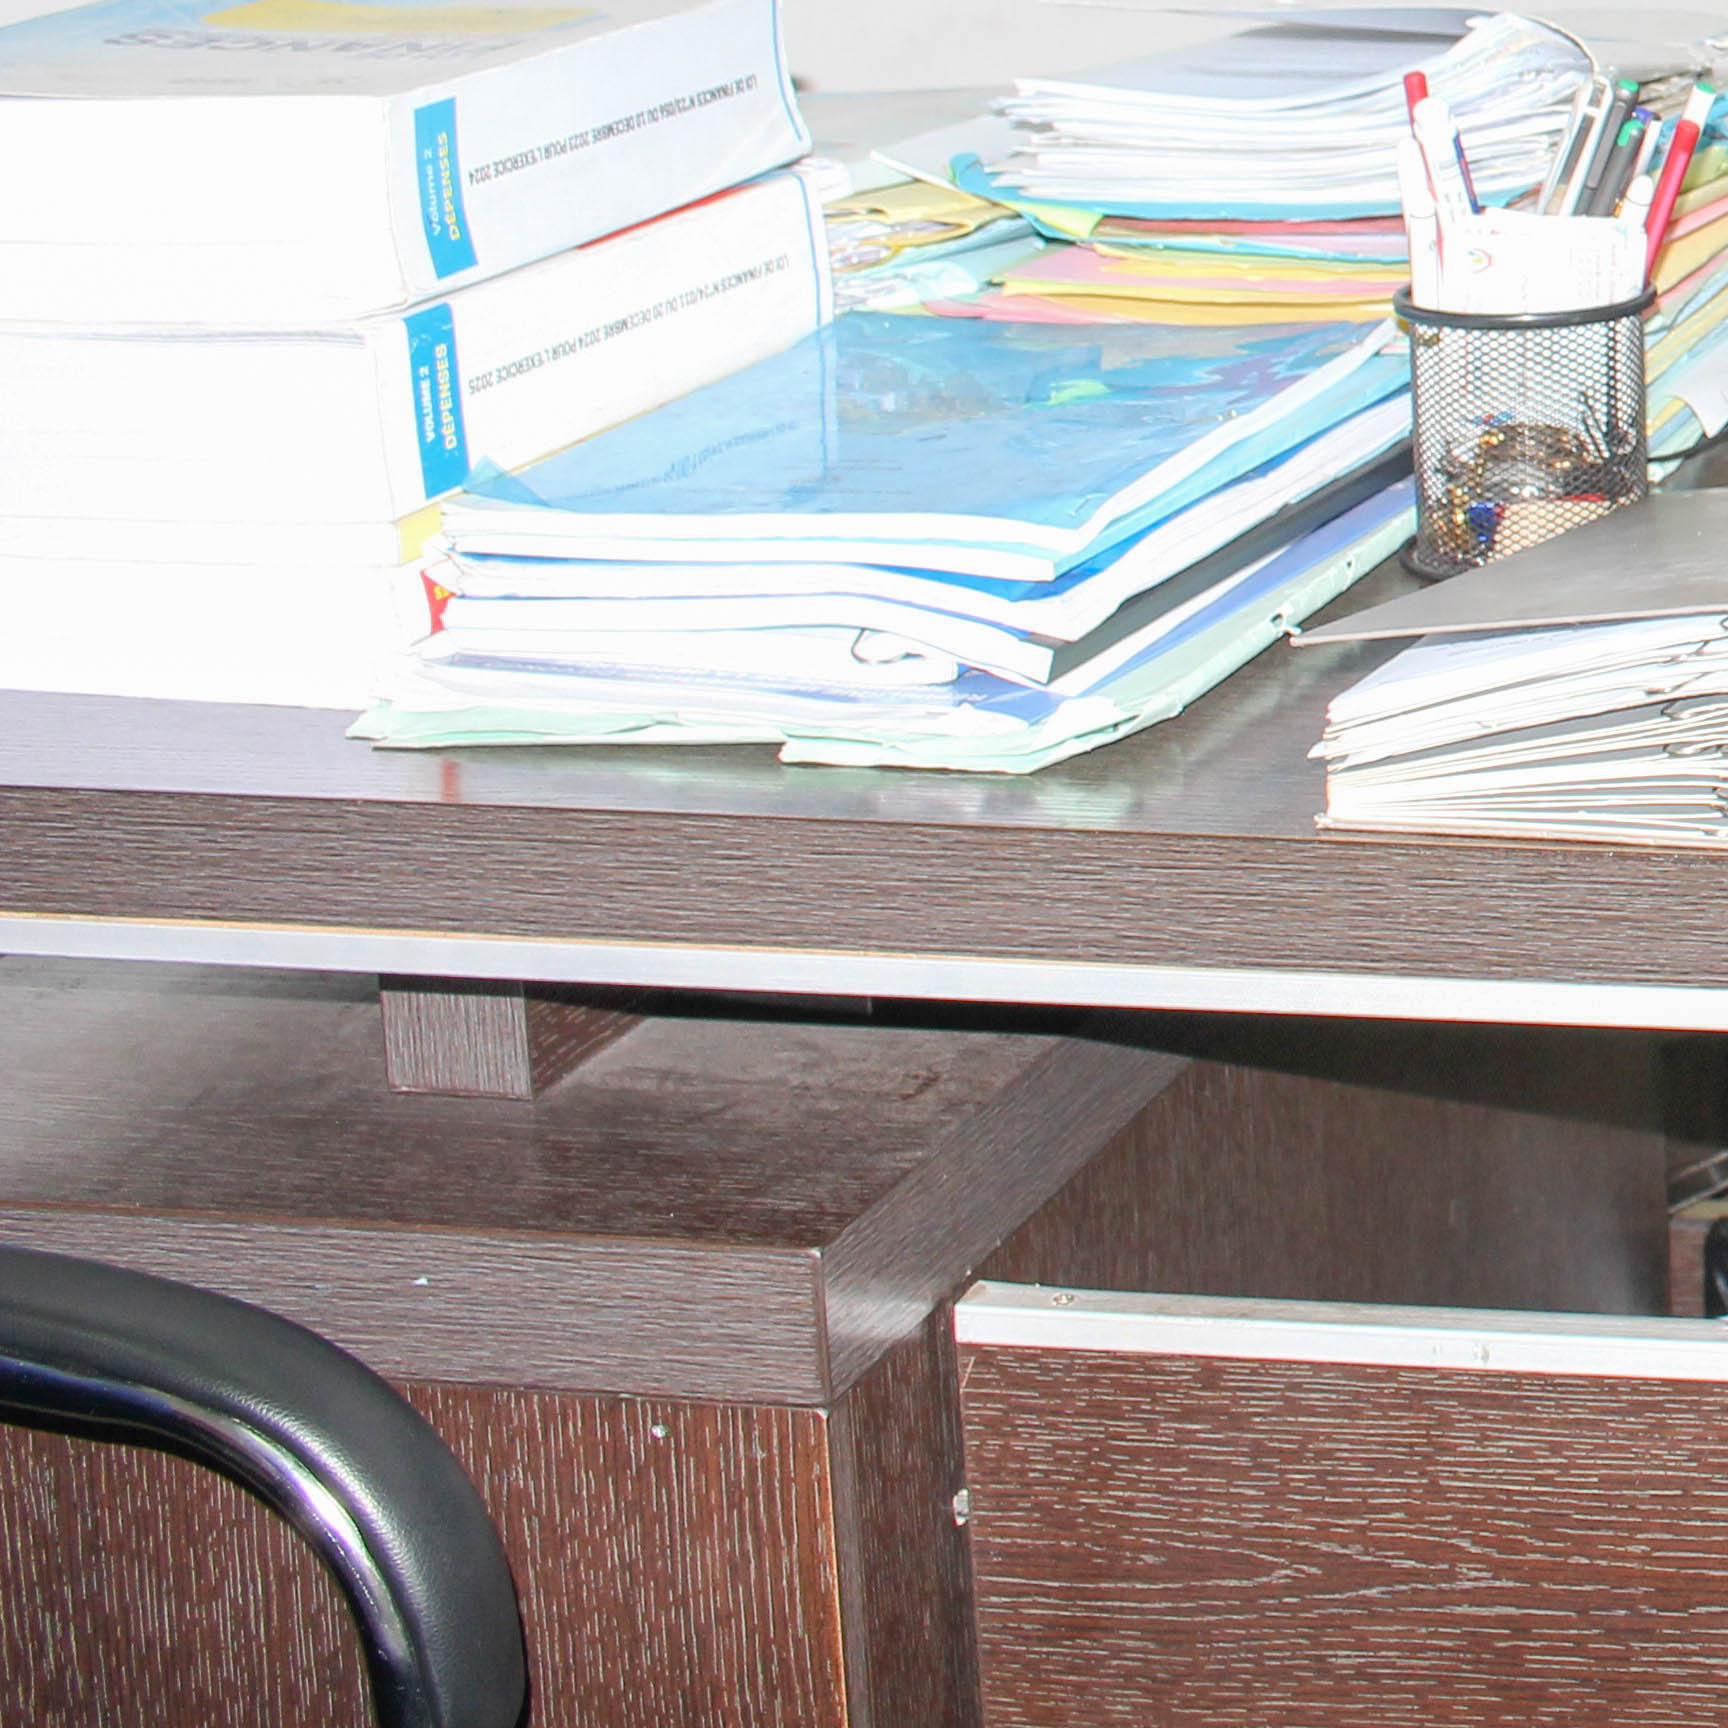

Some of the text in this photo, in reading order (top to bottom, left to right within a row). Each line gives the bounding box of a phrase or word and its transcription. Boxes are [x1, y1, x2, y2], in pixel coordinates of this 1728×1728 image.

[696, 82, 735, 107] FINANCES
[592, 115, 635, 144] DECEMBRE
[544, 138, 568, 160] POUR
[468, 163, 492, 187] 2024
[424, 148, 441, 237] Volume 2
[721, 263, 762, 293] FINANCES
[665, 296, 678, 313] DU
[603, 308, 651, 341] DECEMBRE
[551, 339, 576, 361] POUR
[578, 327, 600, 350] 2024
[468, 371, 493, 395] 2025
[419, 365, 436, 443] VOLUME 2
